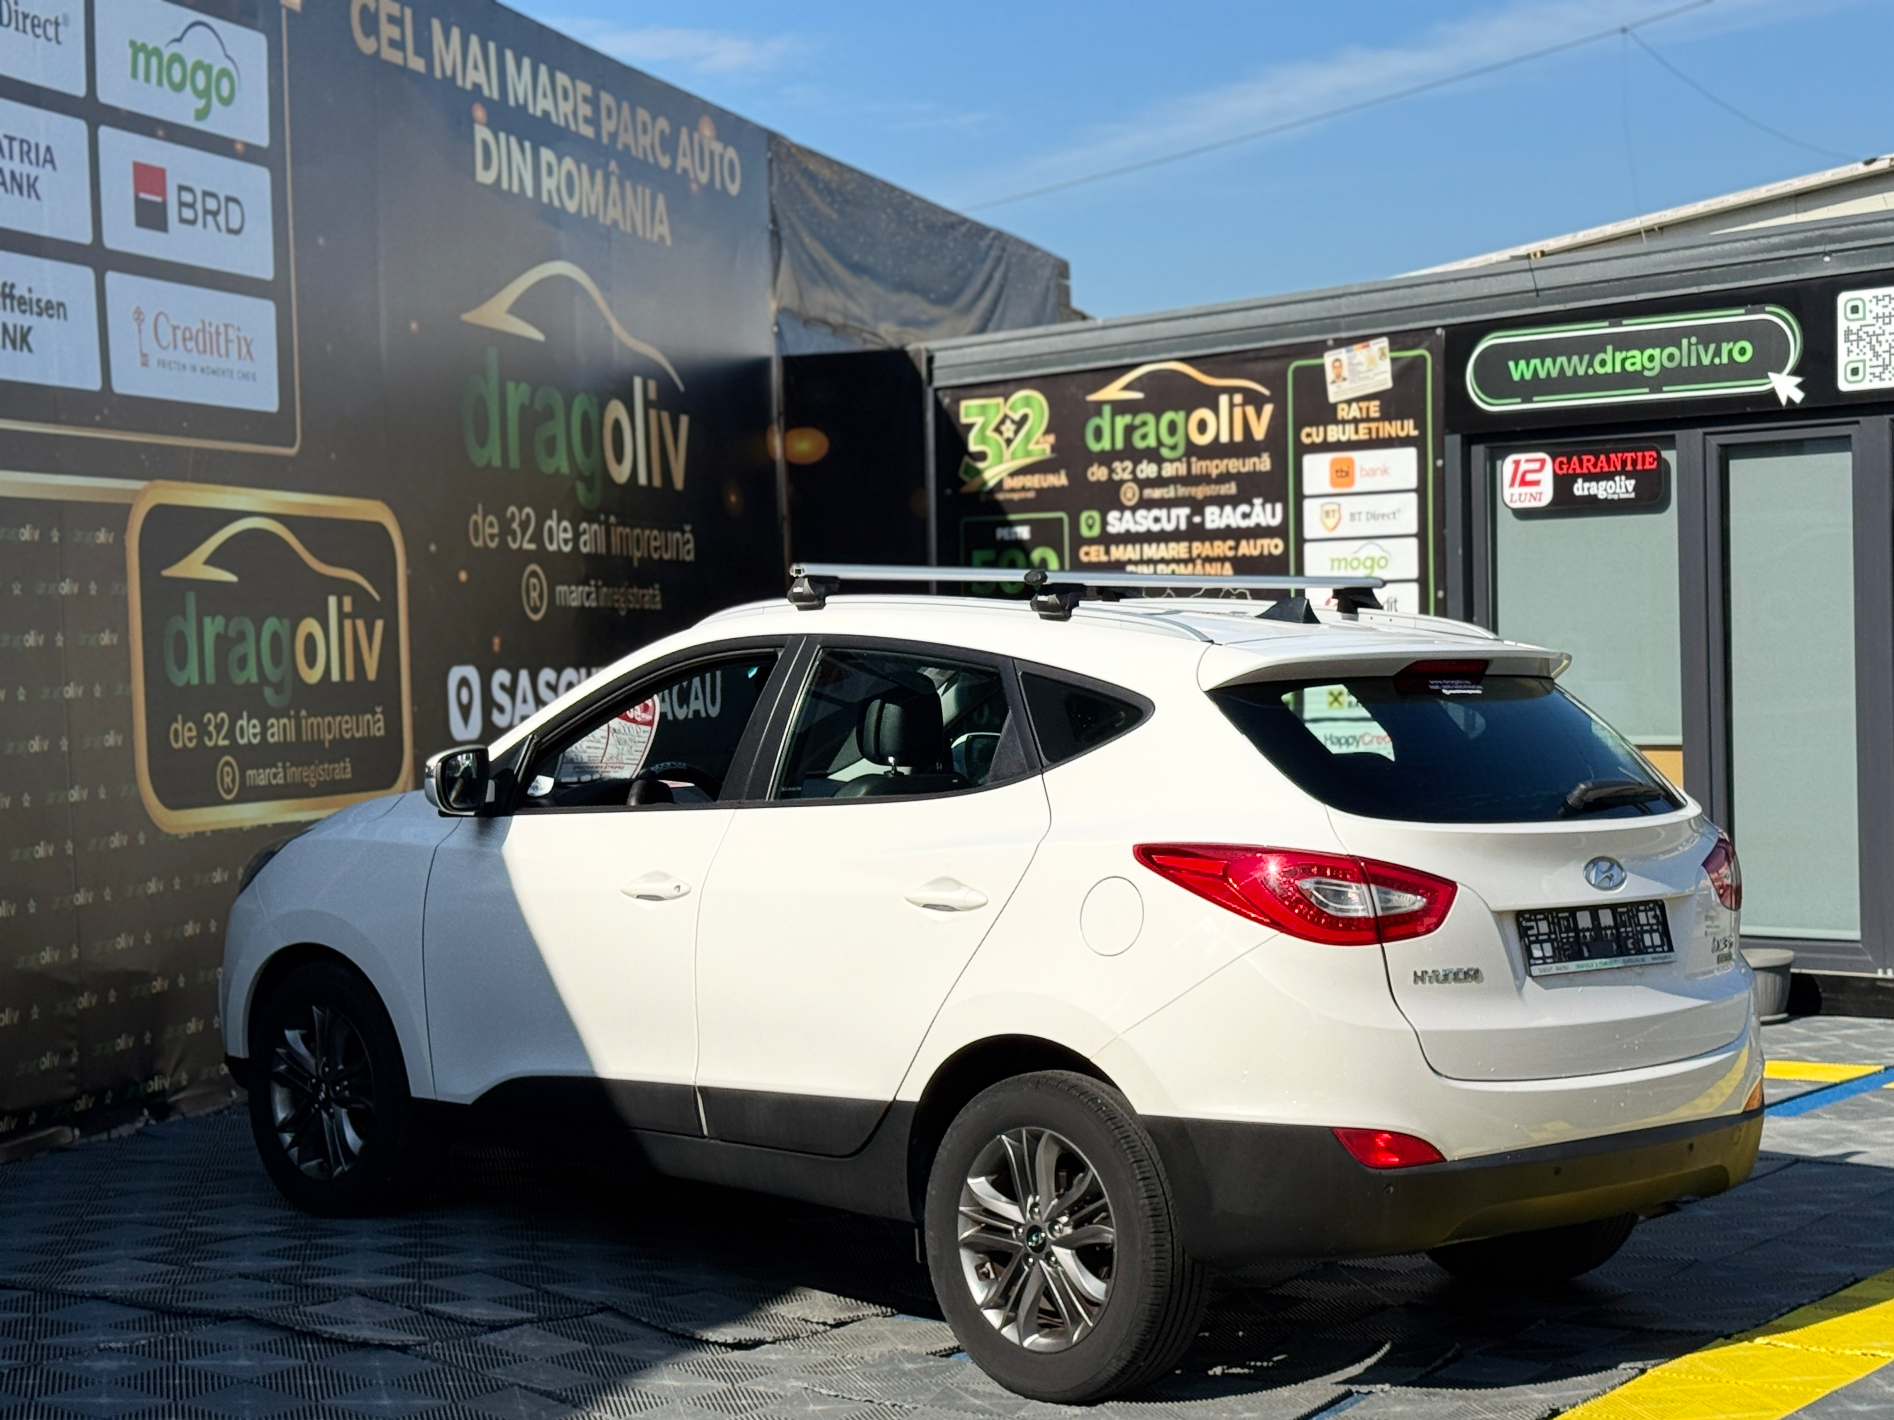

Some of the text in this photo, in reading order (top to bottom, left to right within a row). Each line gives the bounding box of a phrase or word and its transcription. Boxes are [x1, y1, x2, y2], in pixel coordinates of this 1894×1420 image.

[129, 38, 236, 122] mogo
[350, 0, 741, 197] CEL MAI MARE PARC AUTO
[473, 122, 672, 247] DIN ROMÂNIA
[177, 184, 245, 236] BRD
[153, 311, 256, 363] CreditFix
[1507, 336, 1754, 382] www.dragoliv.ro
[461, 346, 690, 510] dragoliv
[959, 388, 1051, 469] 32
[1085, 393, 1275, 459] dragoliv
[1336, 400, 1381, 420] RATE
[1300, 419, 1419, 445] CU BULETINUL
[1087, 462, 1109, 482] de
[1111, 460, 1134, 482] 32
[1136, 459, 1159, 479] de
[1161, 457, 1188, 478] ani
[1335, 465, 1351, 479] tbi
[1359, 463, 1391, 478] bank
[1509, 458, 1547, 489] 12
[1553, 450, 1659, 476] GARANTIE
[1509, 491, 1544, 504] LUNI
[1573, 475, 1636, 499] dragoliv
[468, 503, 500, 549] de
[506, 505, 537, 550] 32
[543, 508, 574, 553] de
[579, 513, 606, 555] ani
[1105, 507, 1192, 535] SASCUT
[1204, 497, 1284, 531] BACĂU
[1078, 538, 1285, 563] CEL MAI MARE PARC AUTO
[1329, 555, 1389, 578] mogo
[163, 590, 385, 709] dragoliv
[490, 666, 606, 728] SASC
[169, 706, 386, 749] de 32 de ani împreună
[246, 761, 285, 787] marcă
[286, 758, 353, 789] înregistrată
